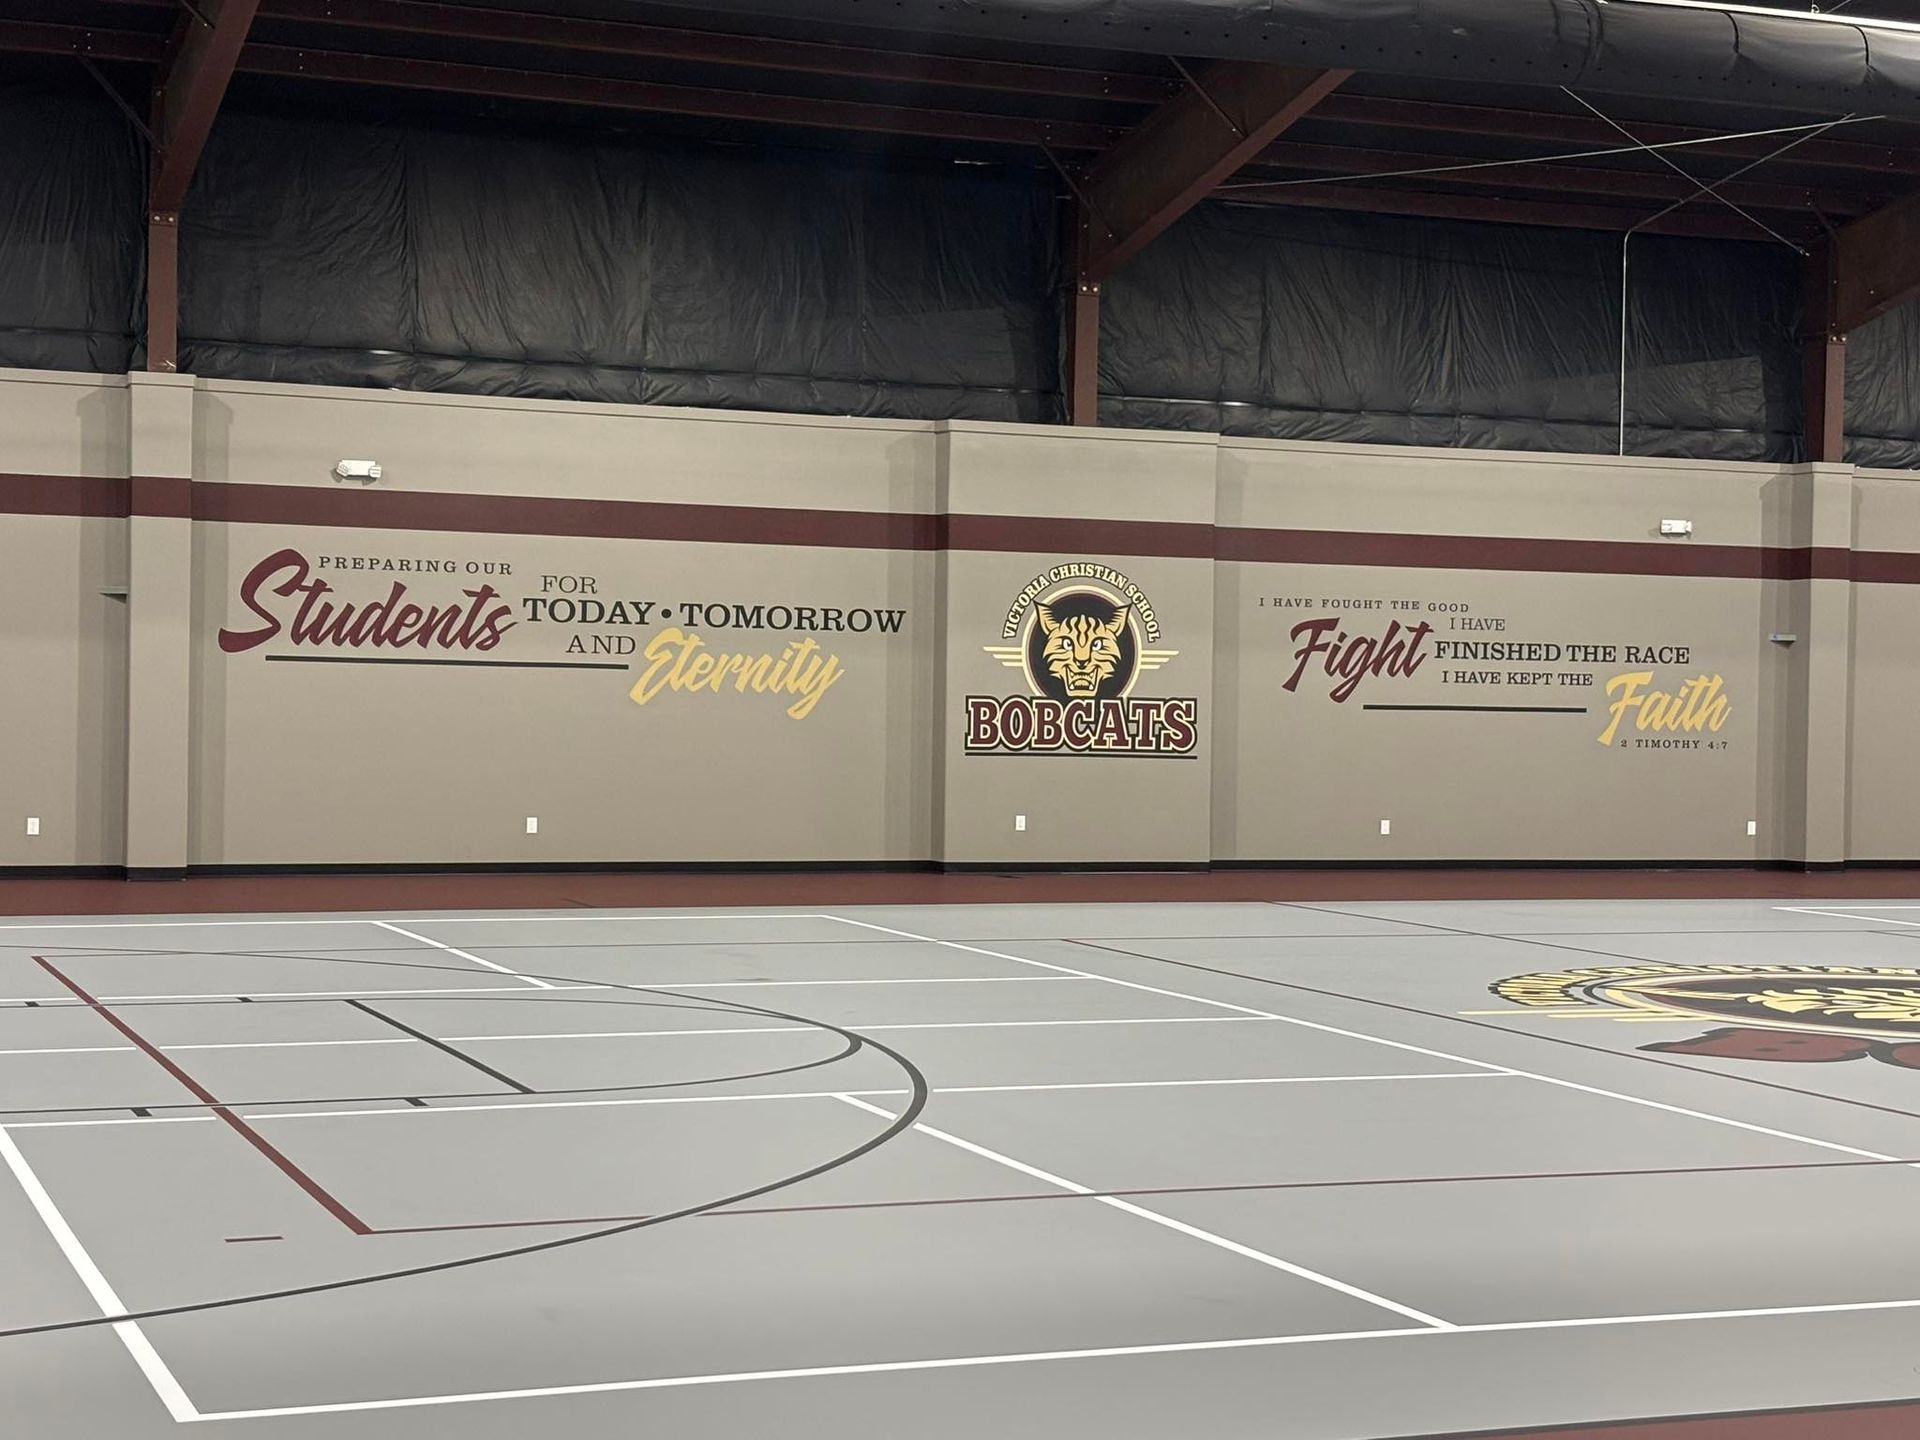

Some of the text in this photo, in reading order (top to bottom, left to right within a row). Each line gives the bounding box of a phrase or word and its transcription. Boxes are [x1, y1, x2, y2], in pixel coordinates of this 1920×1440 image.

[317, 555, 513, 576] PREPARING OUR
[540, 574, 599, 595] FOR
[218, 548, 519, 654] Students
[1002, 562, 1161, 643] VICTORIA CHRISTIAN SCHOOL
[1258, 597, 1470, 613] I HAVE FOUGHT THE GOOD
[522, 597, 907, 633] TODAY TOMORROW
[1448, 615, 1506, 632] I HAVE
[564, 634, 637, 655] AND
[1433, 640, 1693, 665] FINISHED THE RACE
[1281, 617, 1434, 703] Fight
[629, 627, 845, 720] Eternity
[1440, 669, 1596, 688] I HAVE KEPT THE
[1597, 671, 1732, 745] Faith
[965, 695, 1198, 752] BOBCATS
[1620, 738, 1728, 750] 2 TIMOTHY 4:7
